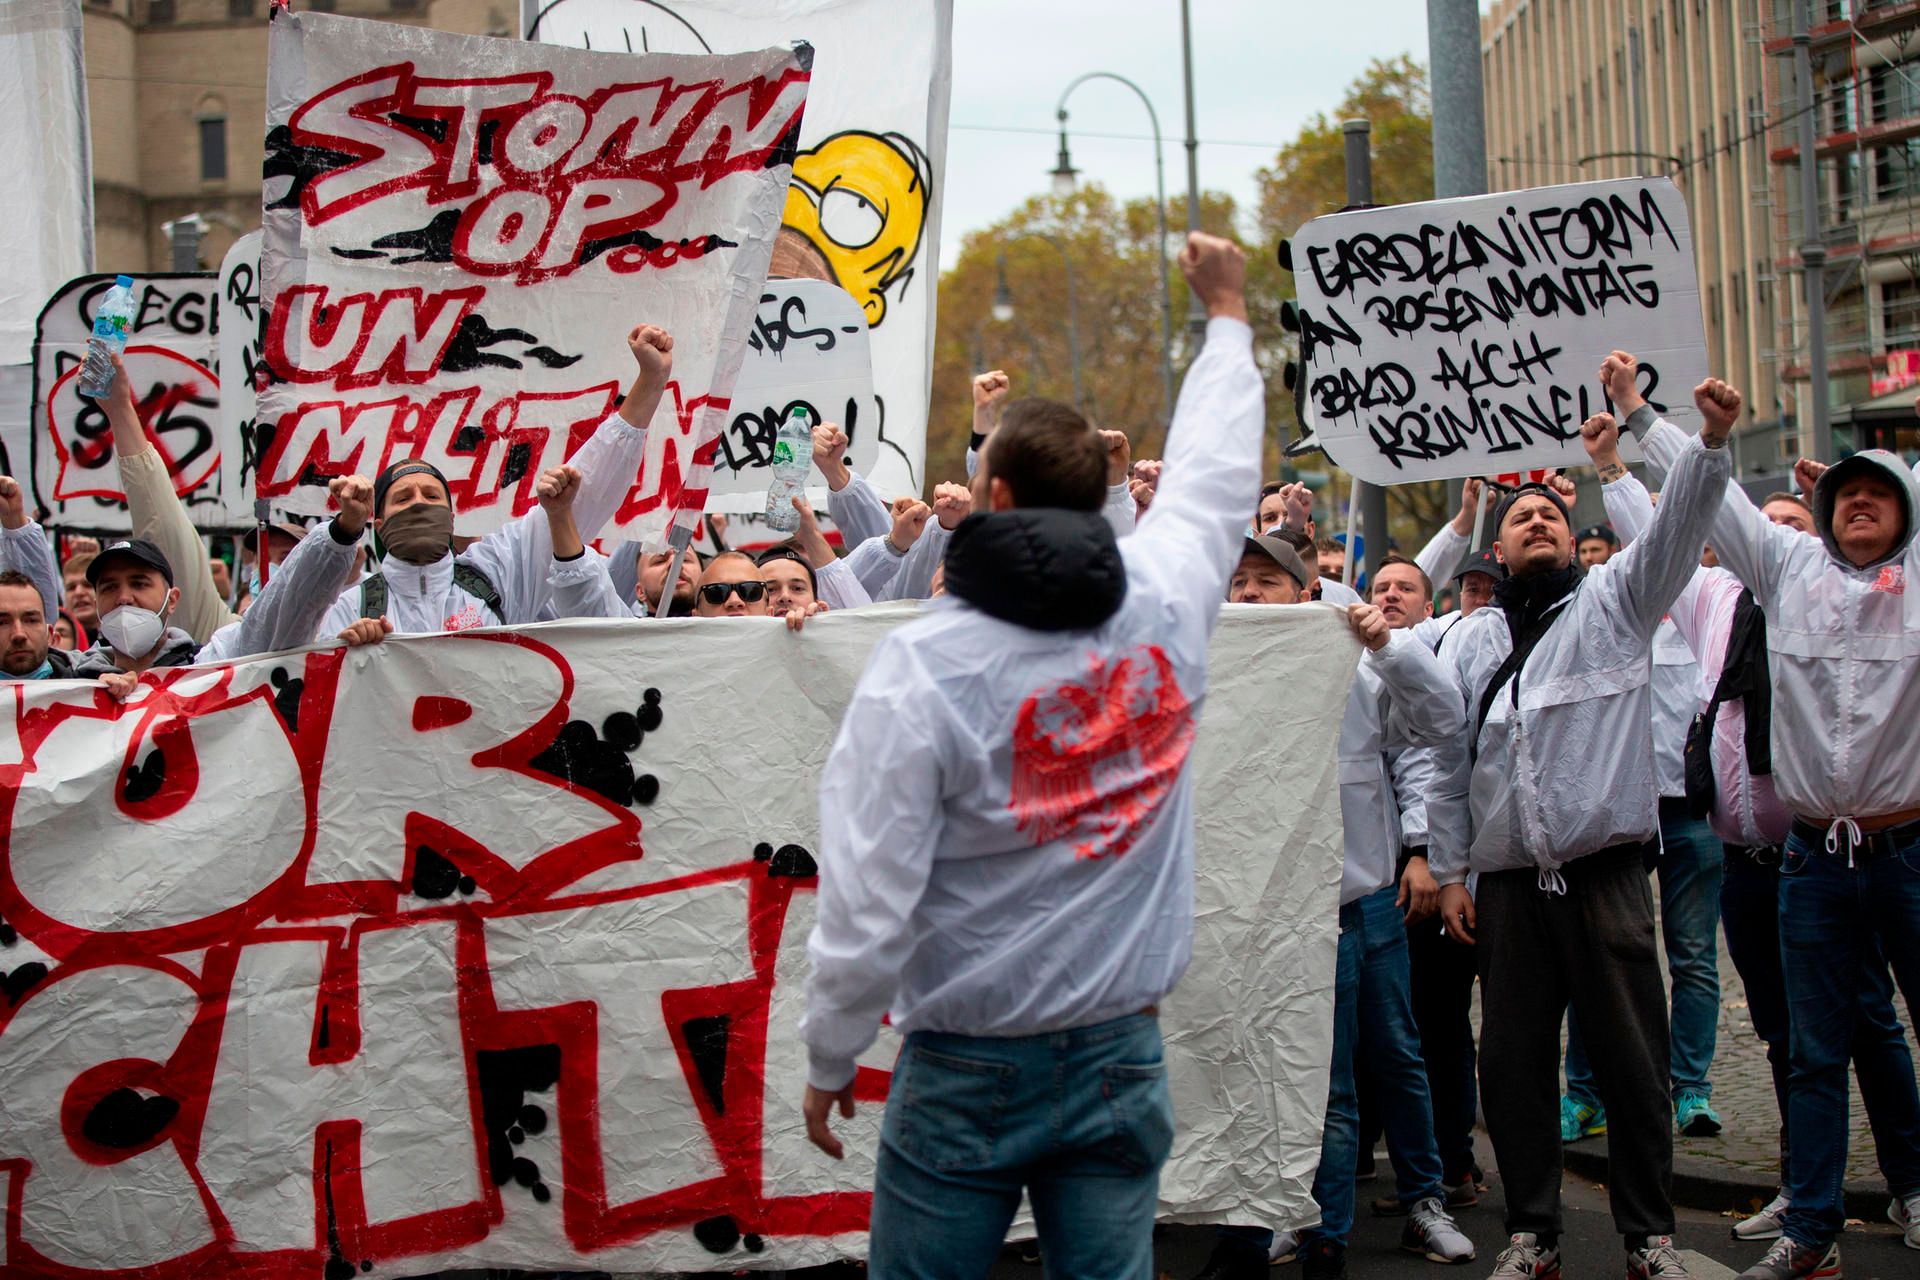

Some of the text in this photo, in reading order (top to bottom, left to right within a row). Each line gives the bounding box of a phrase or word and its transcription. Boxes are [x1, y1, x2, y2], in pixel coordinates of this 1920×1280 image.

[289, 61, 815, 226] STONN
[264, 284, 486, 392] UN
[1299, 260, 1660, 364] AN ROSENMONTAG
[1310, 331, 1562, 424] BALD AUCH
